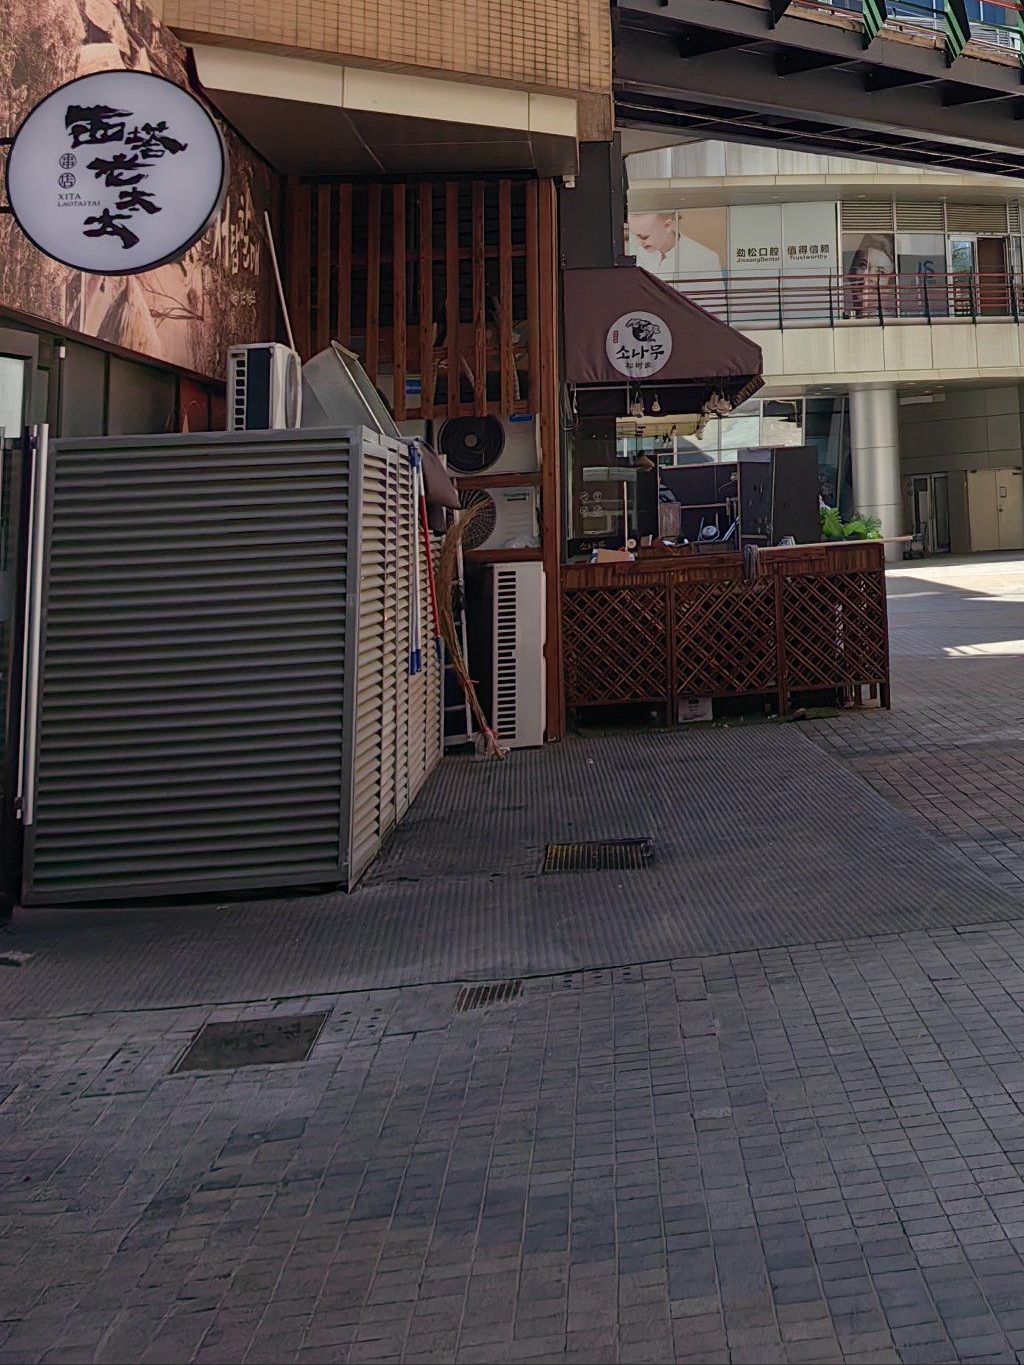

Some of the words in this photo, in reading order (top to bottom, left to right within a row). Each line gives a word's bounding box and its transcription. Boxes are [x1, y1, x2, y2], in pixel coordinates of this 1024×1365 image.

[736, 247, 779, 257] 劲松口腔
[788, 244, 830, 255] 值得信赖
[616, 345, 665, 360] 소나무
